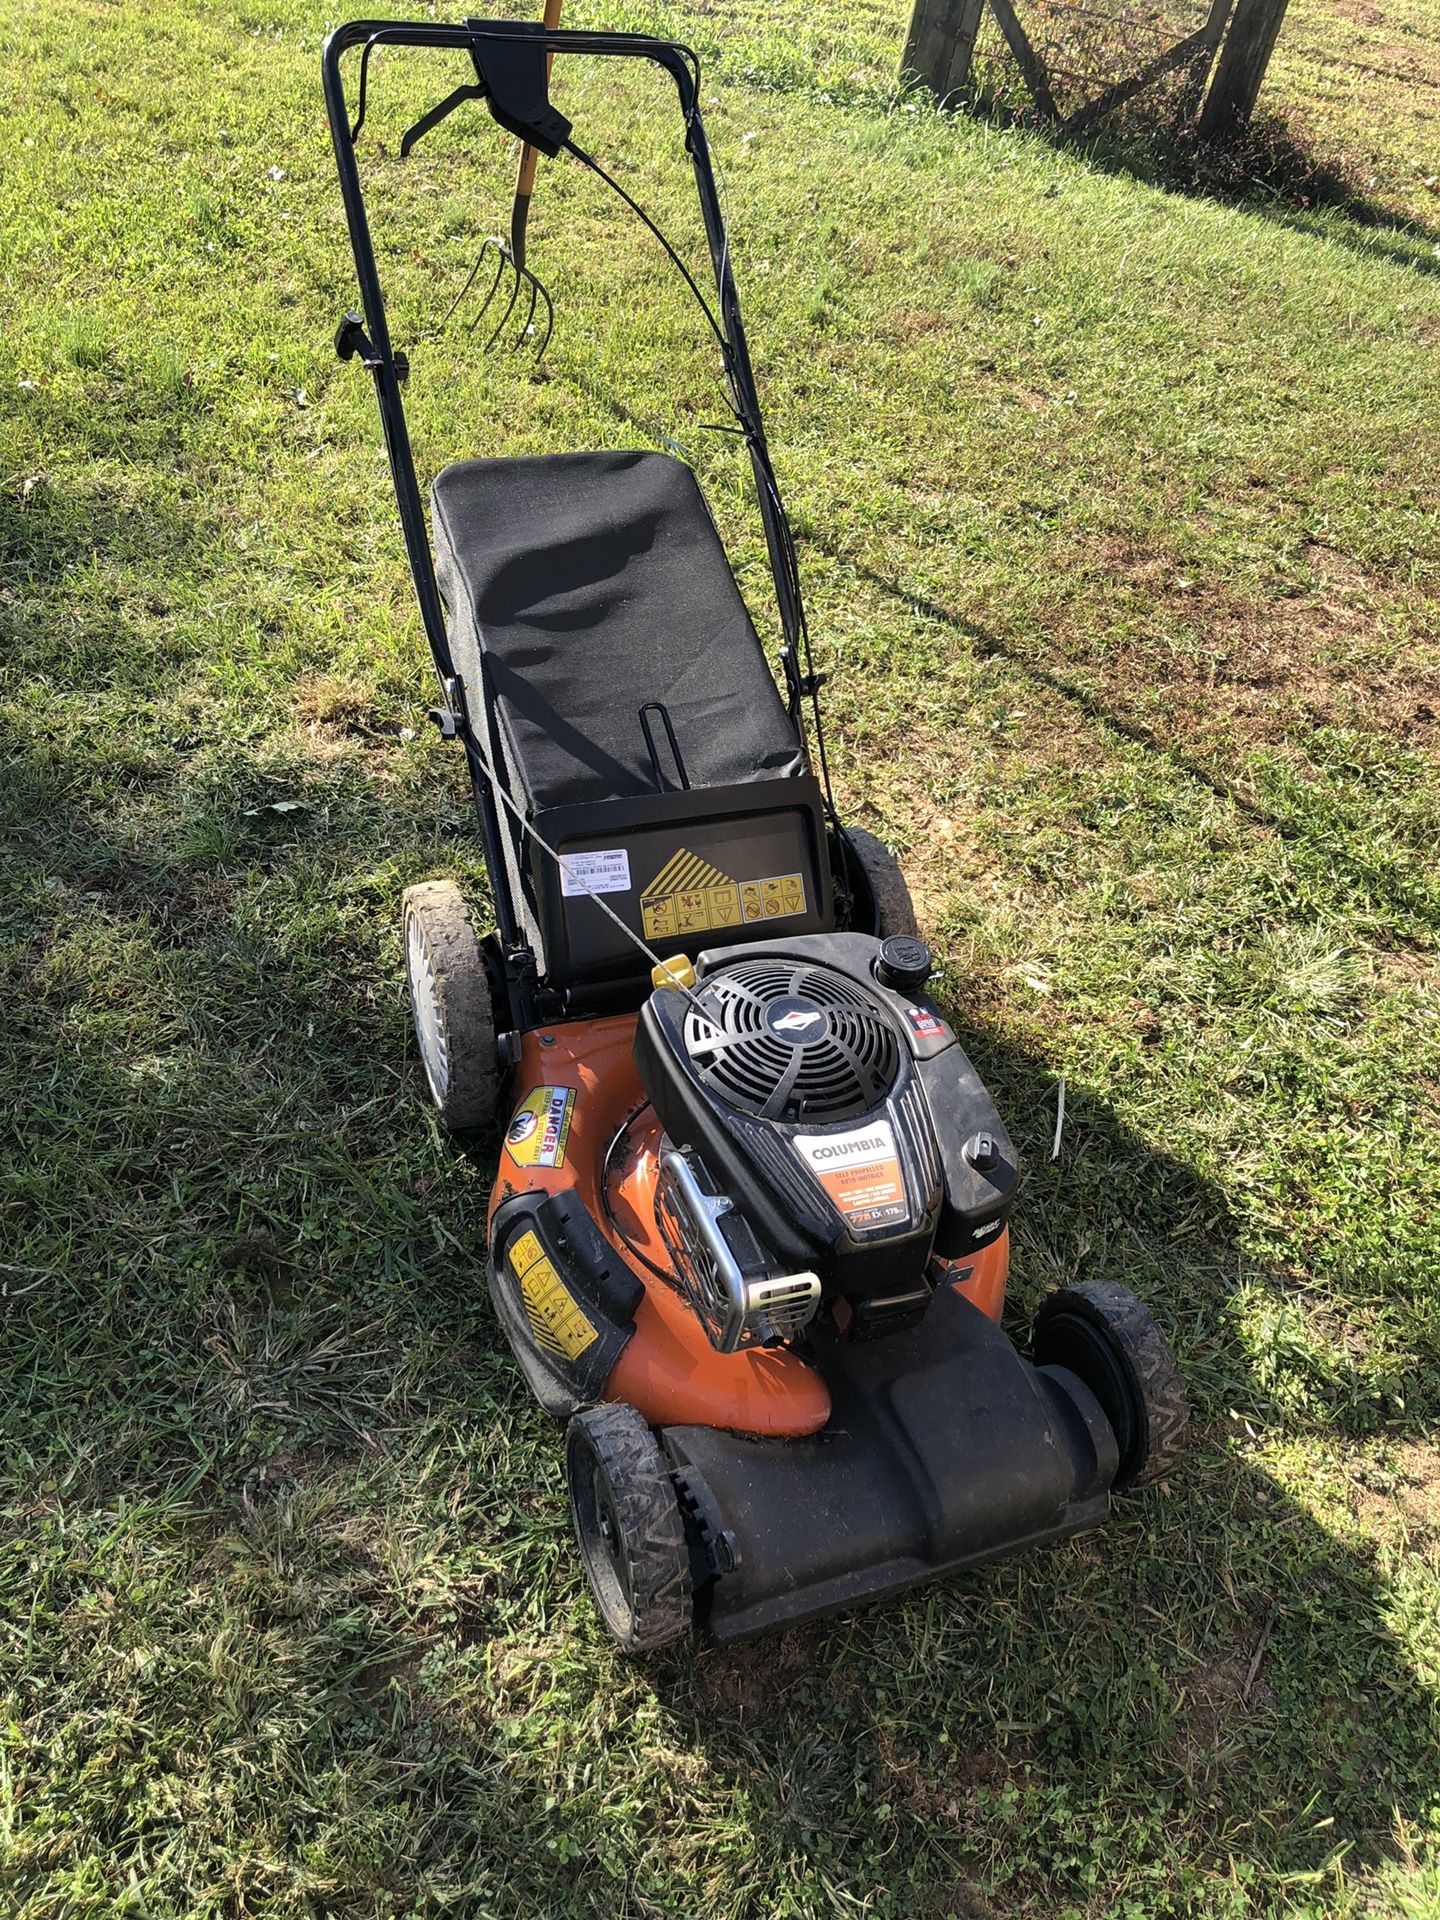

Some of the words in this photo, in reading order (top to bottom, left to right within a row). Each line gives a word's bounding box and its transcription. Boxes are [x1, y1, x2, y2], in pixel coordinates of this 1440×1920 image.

[542, 1099, 563, 1153] DANGER
[812, 1137, 886, 1160] COLUMBIA
[835, 1171, 849, 1180] SELF
[851, 1164, 885, 1178] PROPELLED
[872, 1210, 883, 1219] EX
